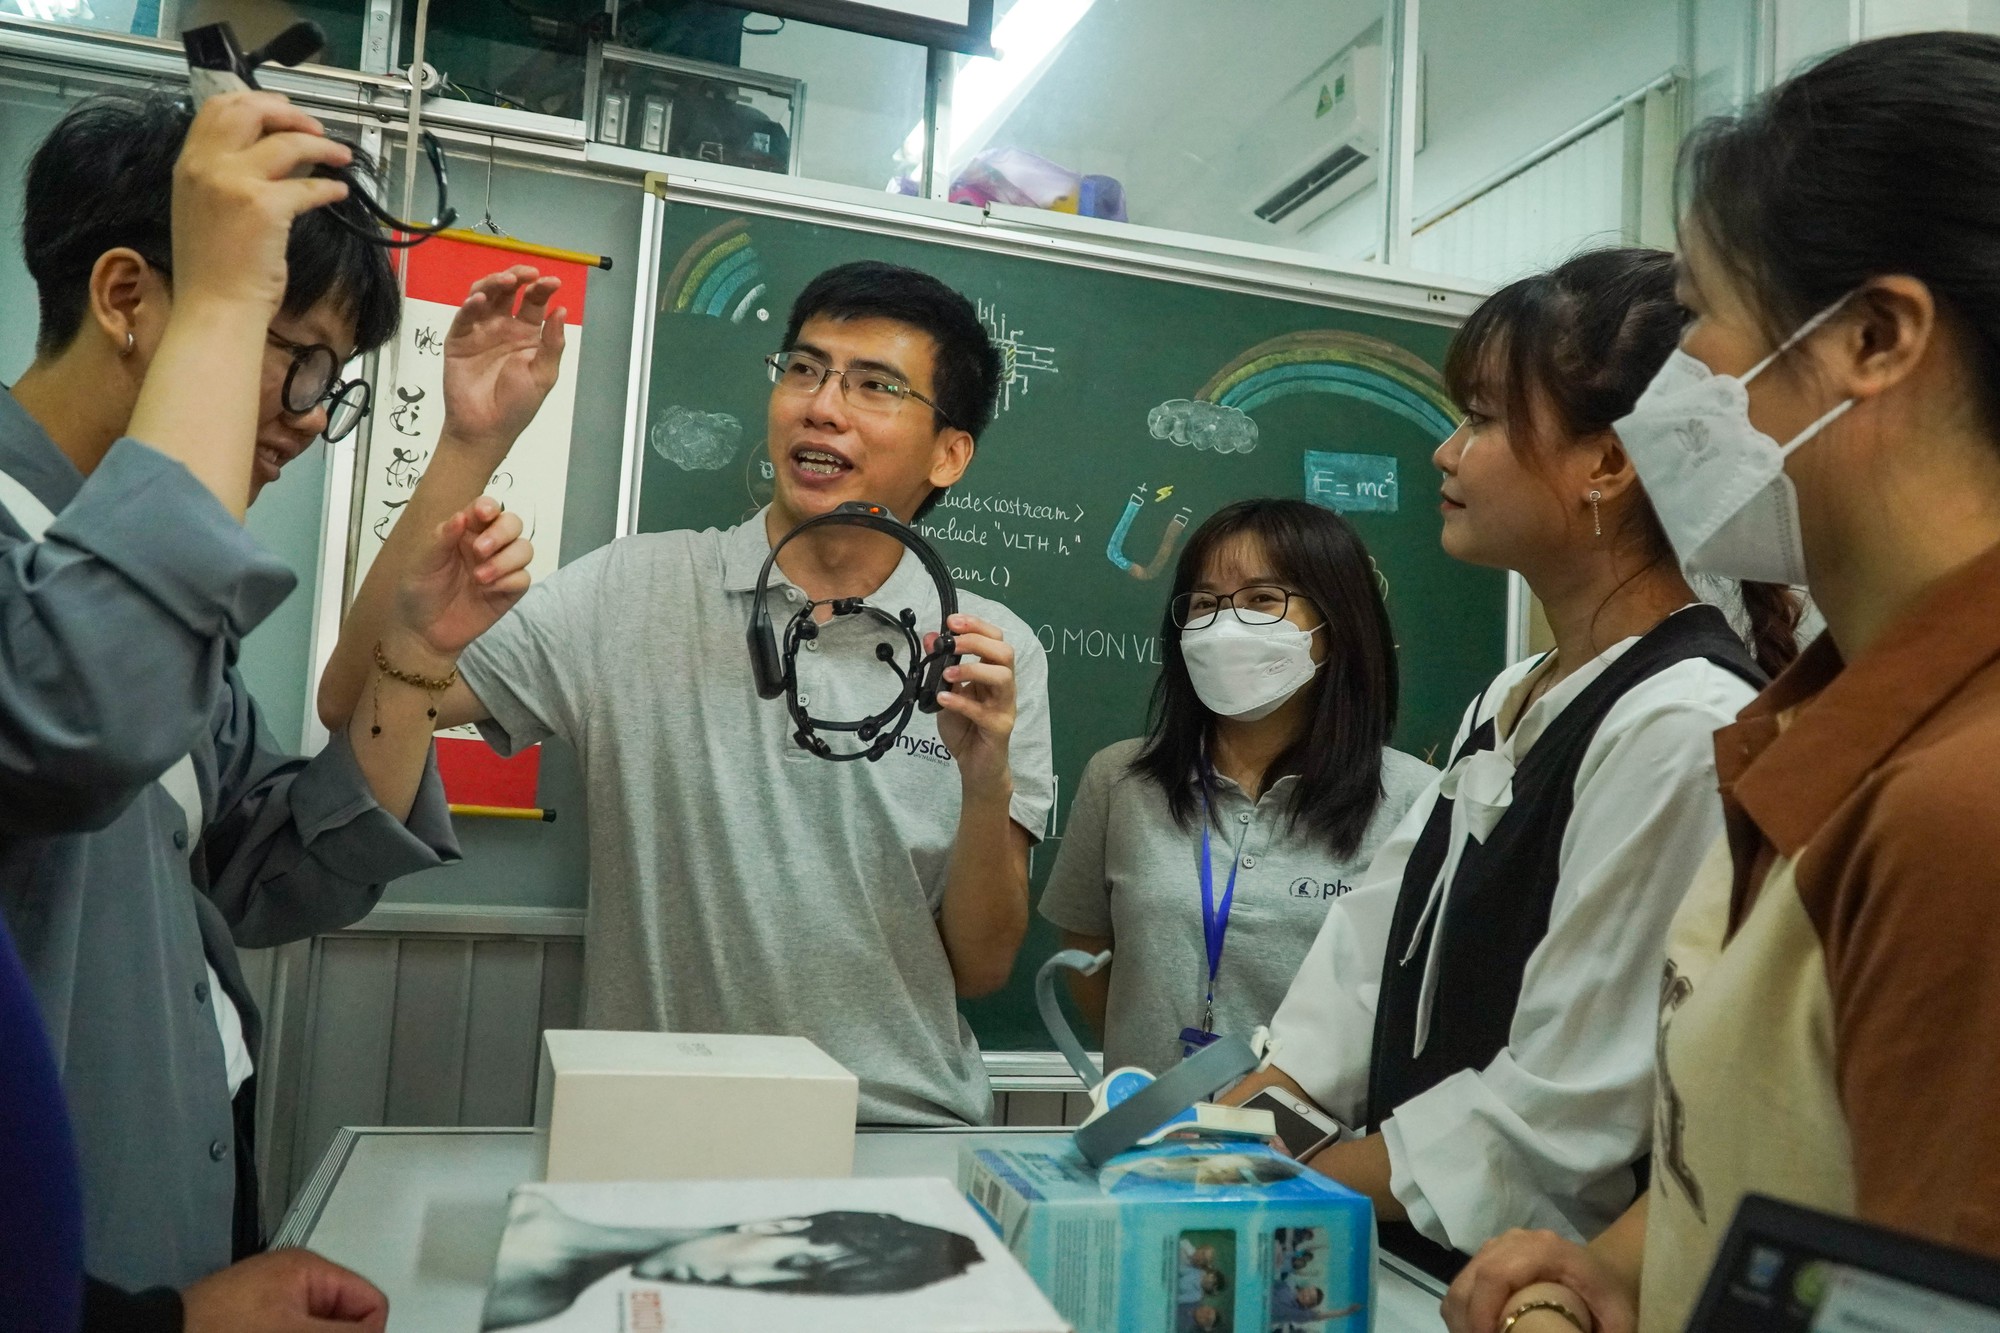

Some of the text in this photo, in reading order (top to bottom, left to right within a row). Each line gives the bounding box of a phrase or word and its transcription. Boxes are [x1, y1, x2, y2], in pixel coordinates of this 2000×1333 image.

[935, 486, 1085, 523] lude<iostream>
[946, 565, 1010, 587] ain()
[1062, 628, 1126, 660] MON
[1133, 634, 1166, 665] VL
[895, 734, 952, 760] hysics
[1323, 879, 1352, 900] ph
